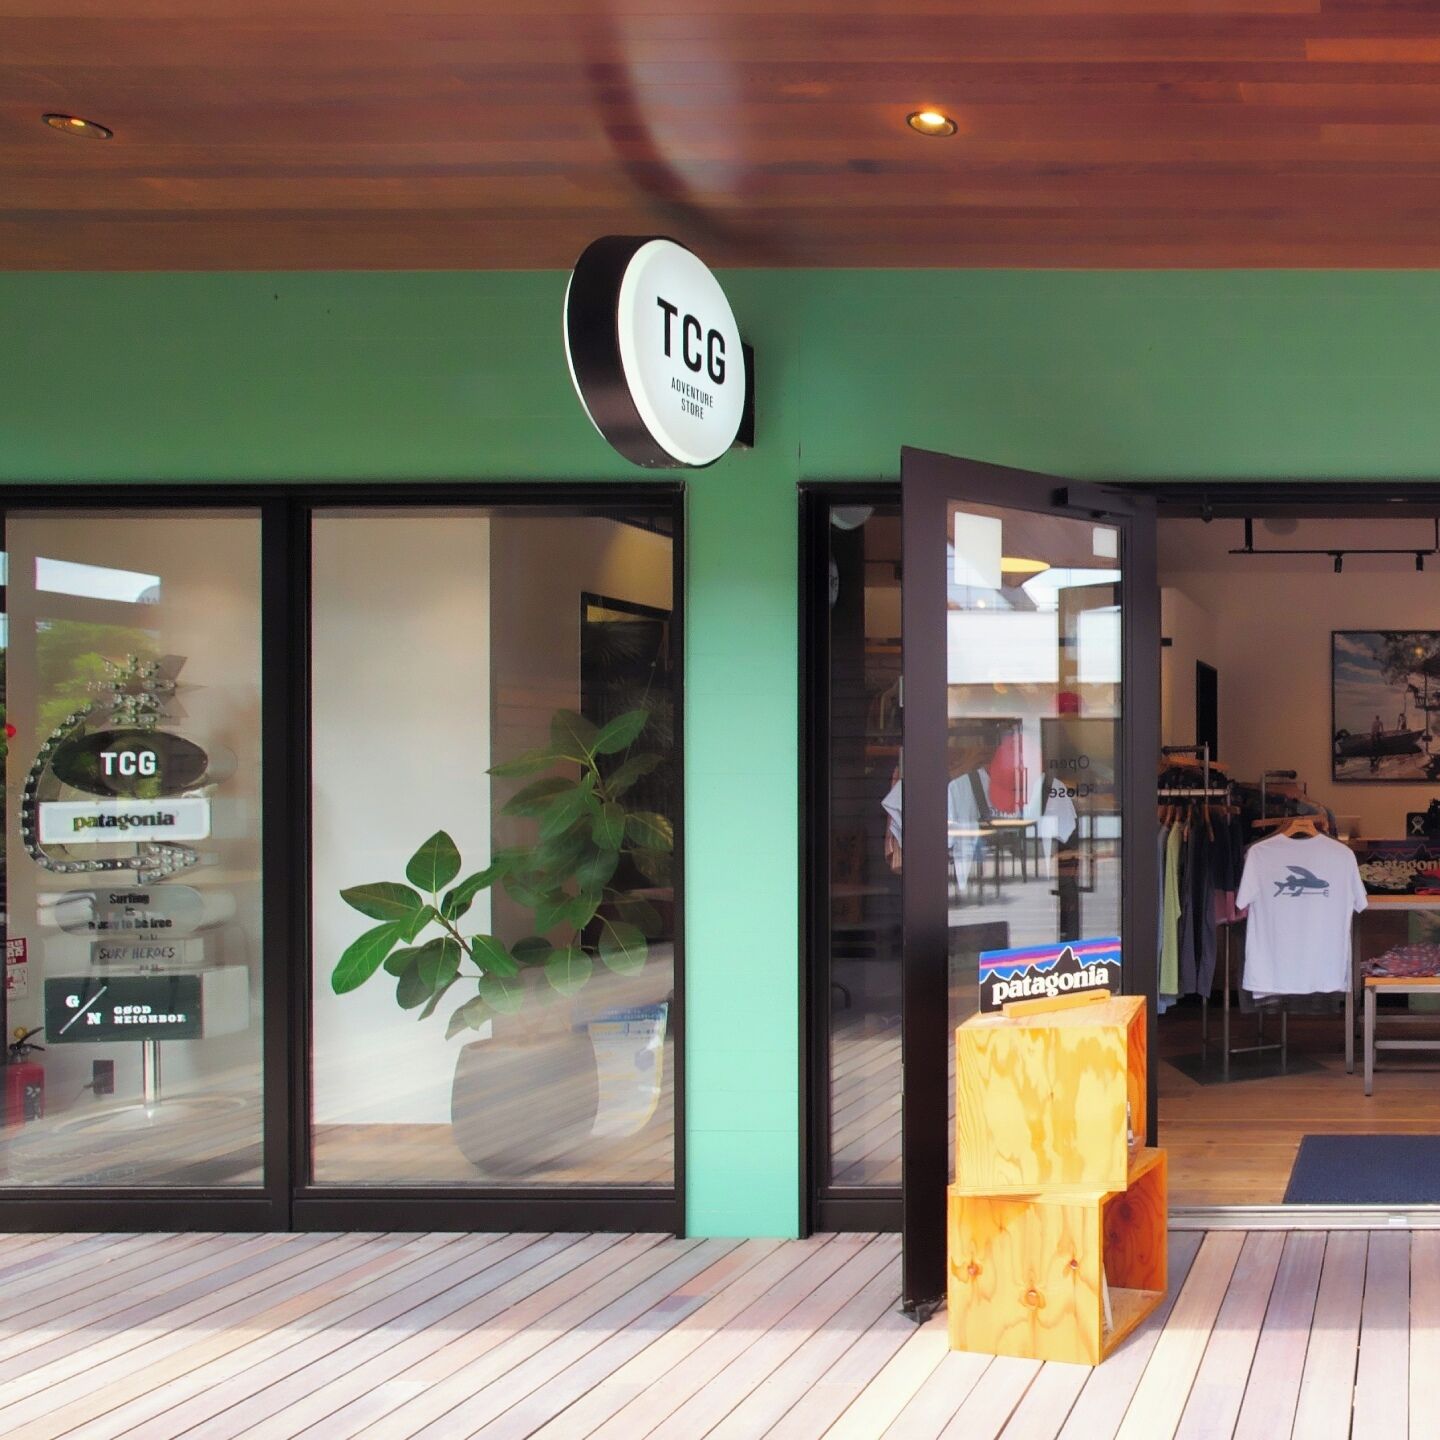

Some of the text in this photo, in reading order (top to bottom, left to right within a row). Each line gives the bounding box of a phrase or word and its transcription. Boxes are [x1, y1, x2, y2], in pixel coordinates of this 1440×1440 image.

[656, 295, 727, 386] TCG
[671, 376, 714, 408] ADVENTURE
[681, 398, 705, 420] STORE
[100, 751, 157, 776] TCG
[72, 811, 176, 832] patagonia
[992, 965, 1110, 1006] patagonia
[113, 1014, 187, 1025] NEIGHBOR
